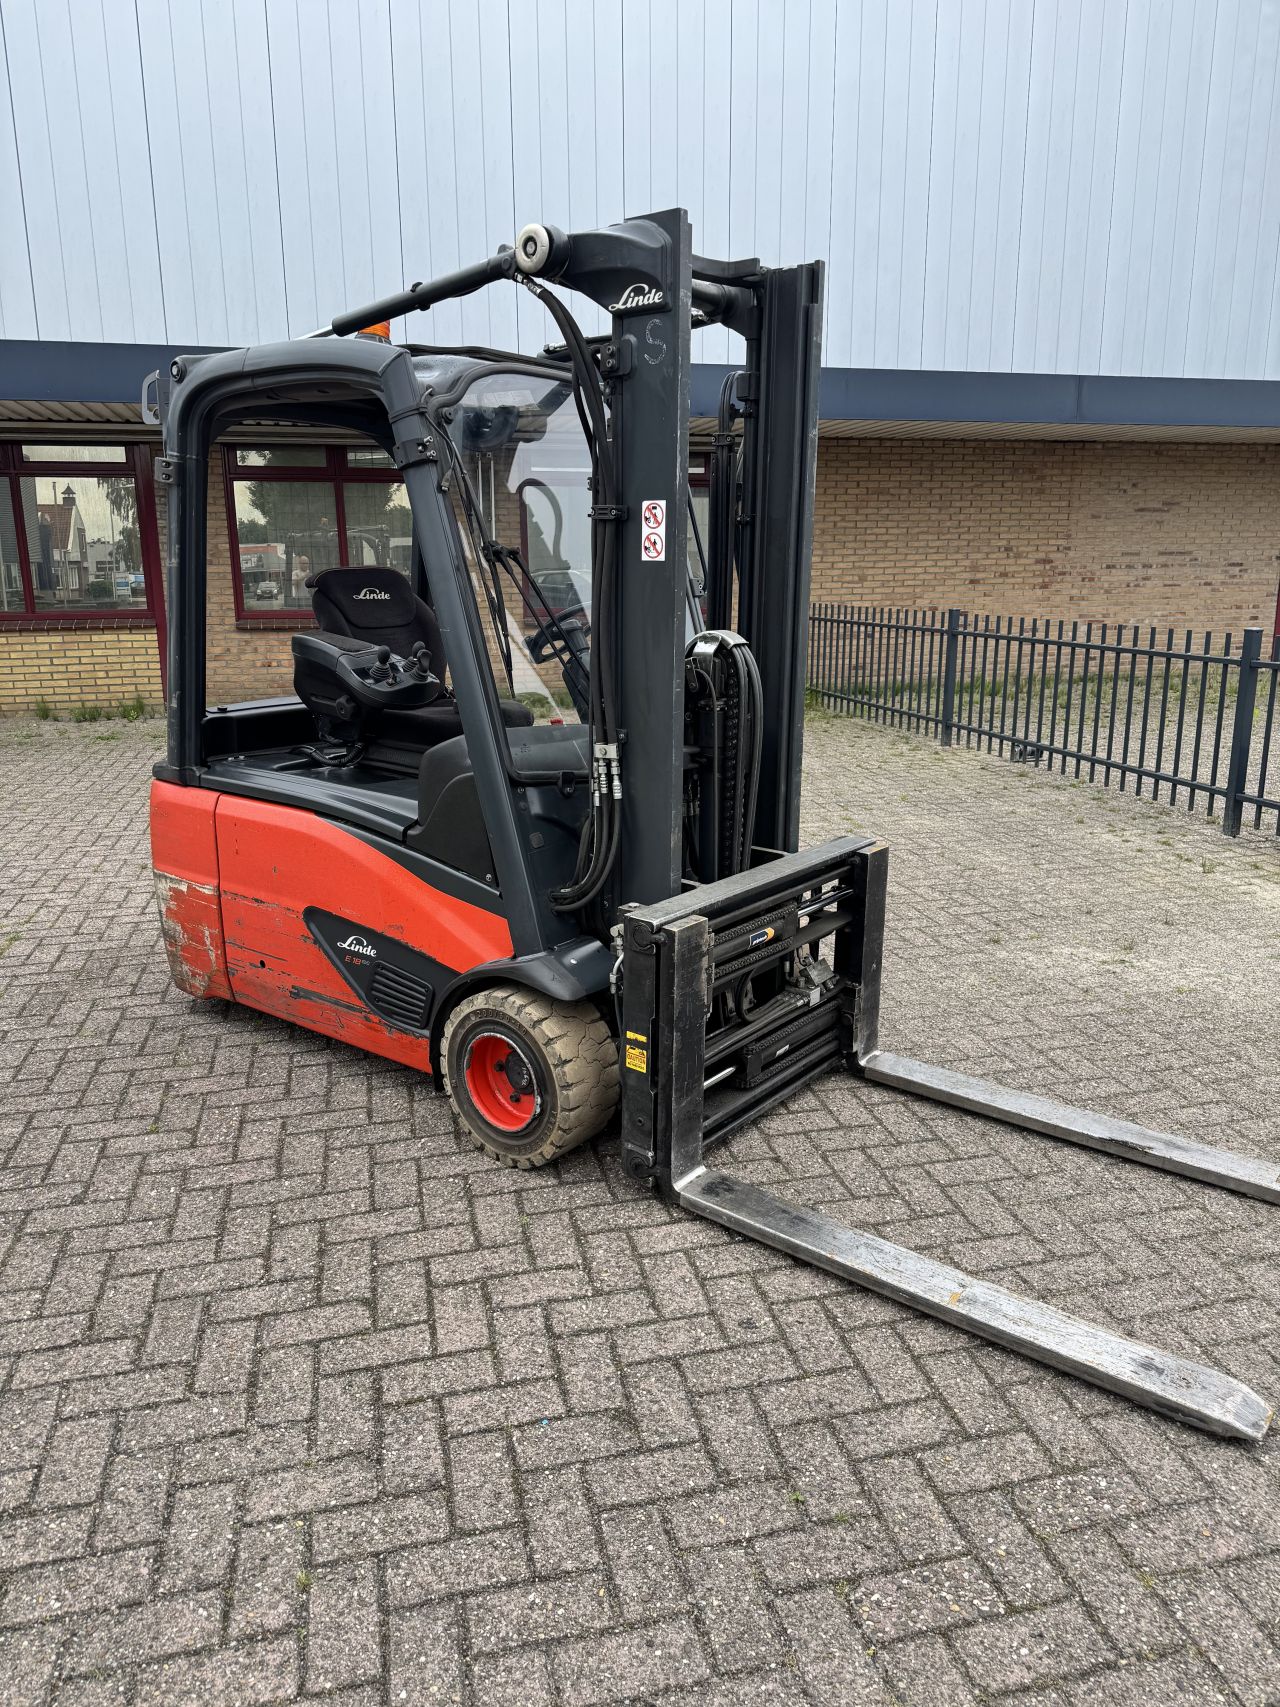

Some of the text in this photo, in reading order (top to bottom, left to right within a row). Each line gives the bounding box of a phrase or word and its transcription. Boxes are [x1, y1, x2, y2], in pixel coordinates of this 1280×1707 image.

[608, 283, 663, 311] Linde
[352, 587, 391, 600] Linde
[336, 935, 377, 957] Linde
[345, 955, 352, 963] E
